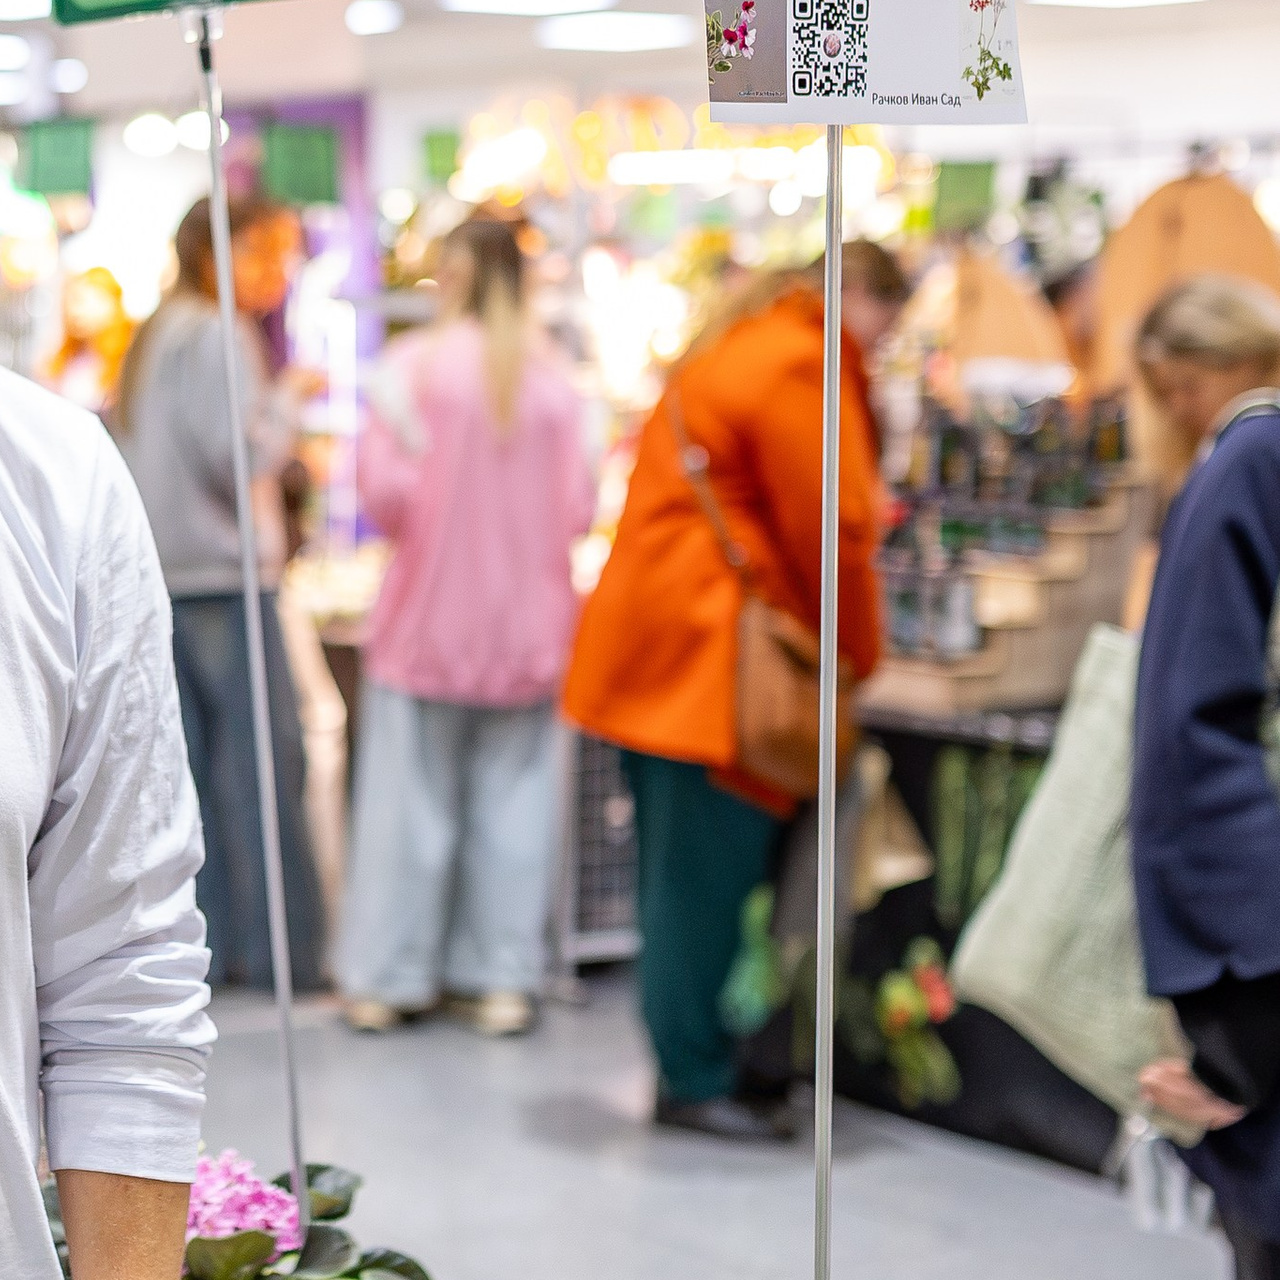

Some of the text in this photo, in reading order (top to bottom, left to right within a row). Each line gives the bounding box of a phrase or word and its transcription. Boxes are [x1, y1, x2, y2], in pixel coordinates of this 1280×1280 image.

[871, 92, 961, 108] Рачков Иван Сад
